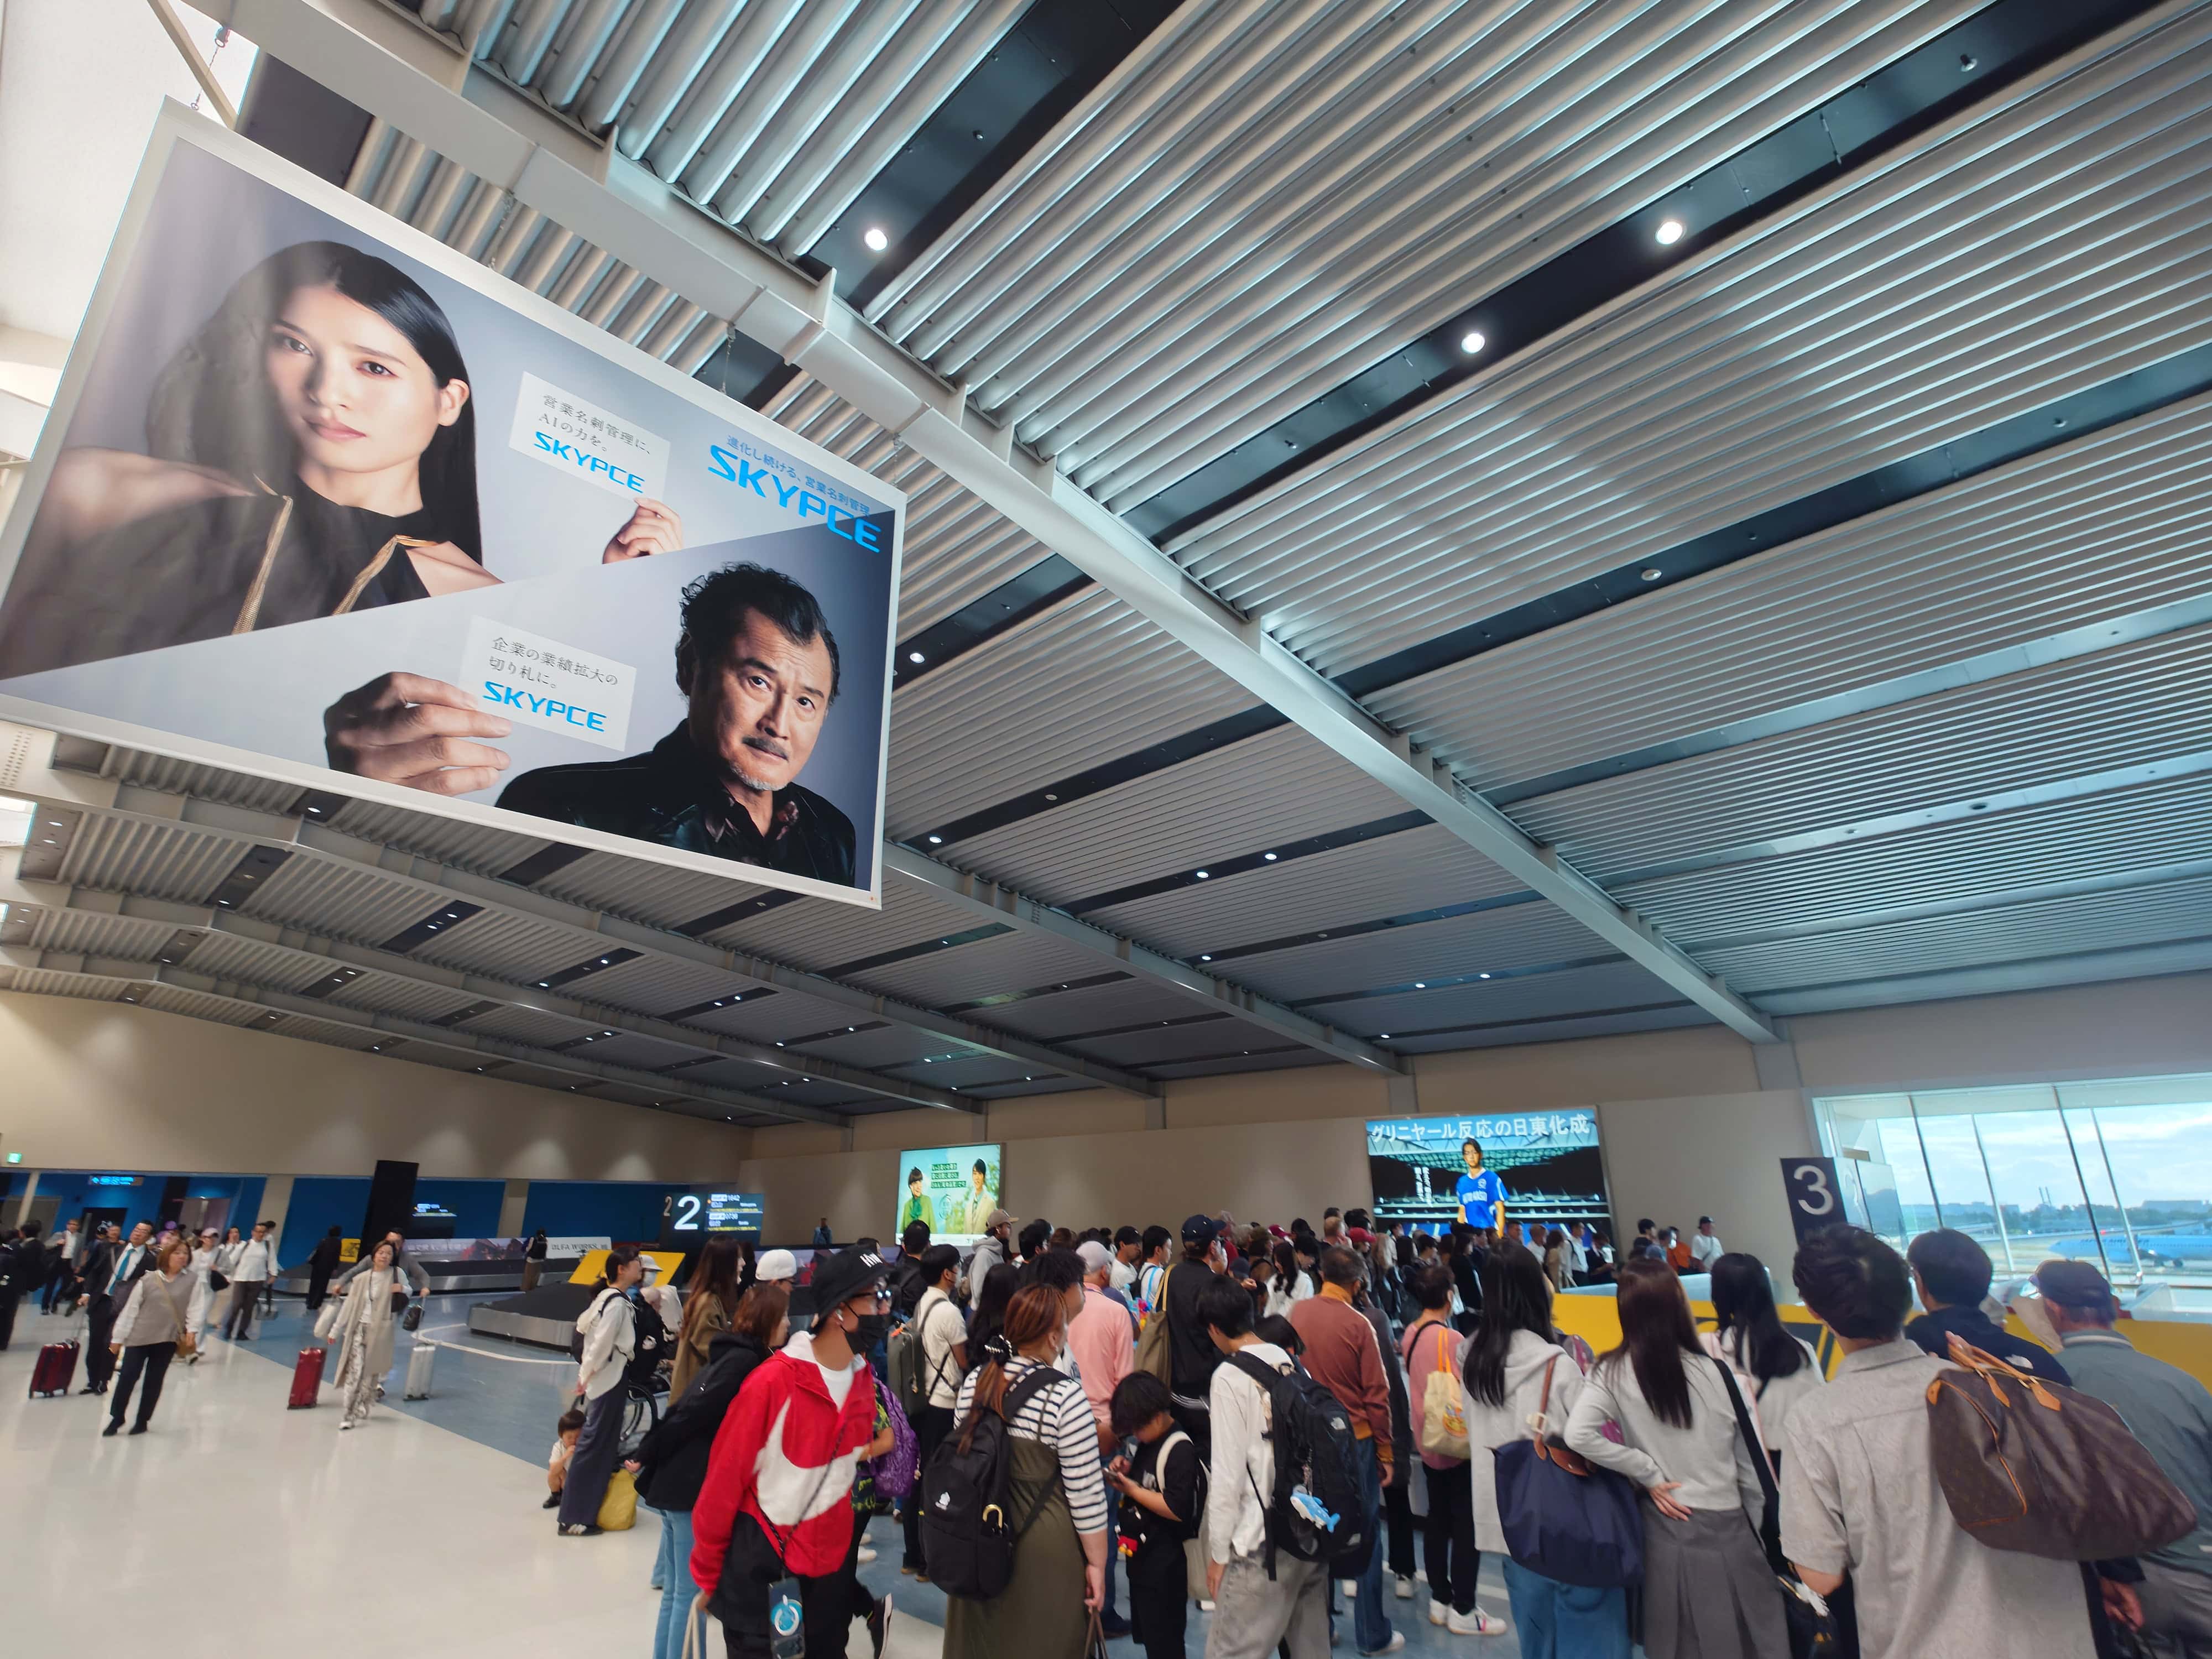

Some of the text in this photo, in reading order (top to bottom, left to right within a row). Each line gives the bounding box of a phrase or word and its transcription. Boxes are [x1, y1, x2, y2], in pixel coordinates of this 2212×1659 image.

[538, 413, 607, 452] AIの力を。
[542, 394, 650, 455] 営業名刺管理に、
[534, 431, 646, 494] SKYPCE
[707, 445, 881, 553] SKYPCE
[489, 656, 557, 689] 切り札に。
[491, 637, 618, 685] 企業の業績拡大の
[482, 681, 607, 732] SKYPCE
[664, 1196, 672, 1217] 2
[674, 1196, 701, 1230] 2
[1793, 1165, 1834, 1215] 3
